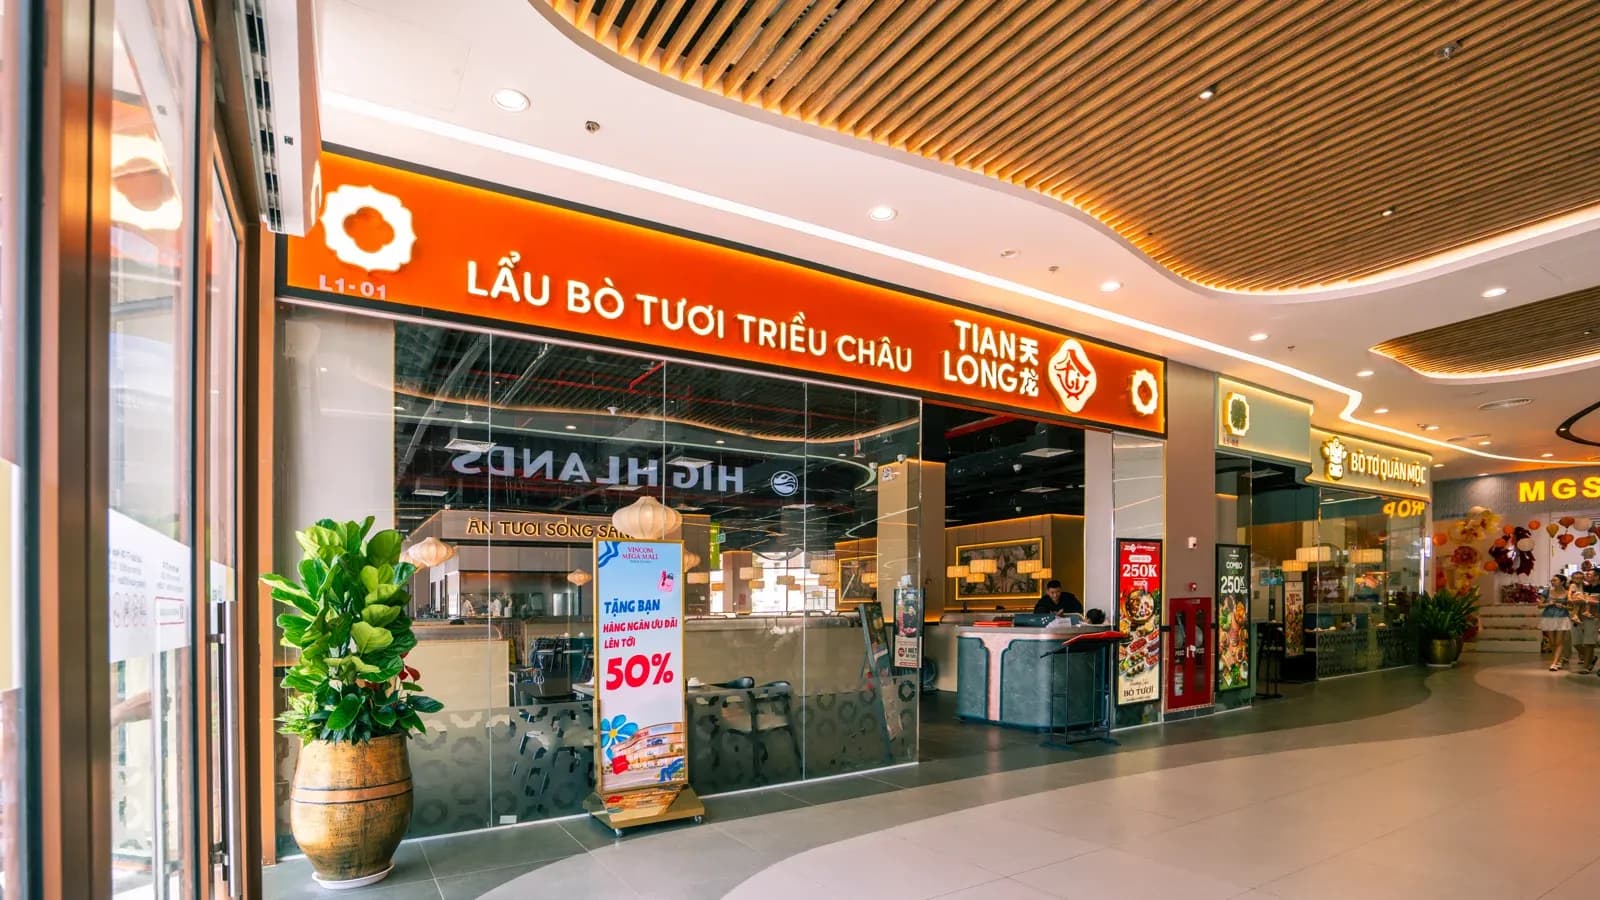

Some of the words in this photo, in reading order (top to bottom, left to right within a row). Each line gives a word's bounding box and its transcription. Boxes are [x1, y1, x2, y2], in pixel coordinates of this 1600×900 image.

[318, 274, 387, 300] L1-01
[467, 250, 550, 306] LẨU
[566, 277, 625, 320] BÒ
[635, 293, 725, 339] TƯƠI
[737, 311, 828, 357] TRIỀU
[836, 335, 913, 373] CHÂU
[953, 319, 1016, 362] TIAN
[943, 349, 1018, 393] LONG
[1019, 336, 1039, 398] 天龙
[1351, 448, 1366, 473] BÒ
[466, 517, 495, 535] ĂN
[499, 520, 542, 536] TƯƠI
[627, 546, 654, 554] VINCOM
[1122, 563, 1157, 578] 250K
[604, 598, 635, 617] TẶNG
[637, 599, 661, 615] BẠN
[602, 621, 626, 633] HÀNG
[604, 637, 620, 649] LÊN
[621, 635, 636, 647] TỚI
[605, 652, 674, 691] 50%
